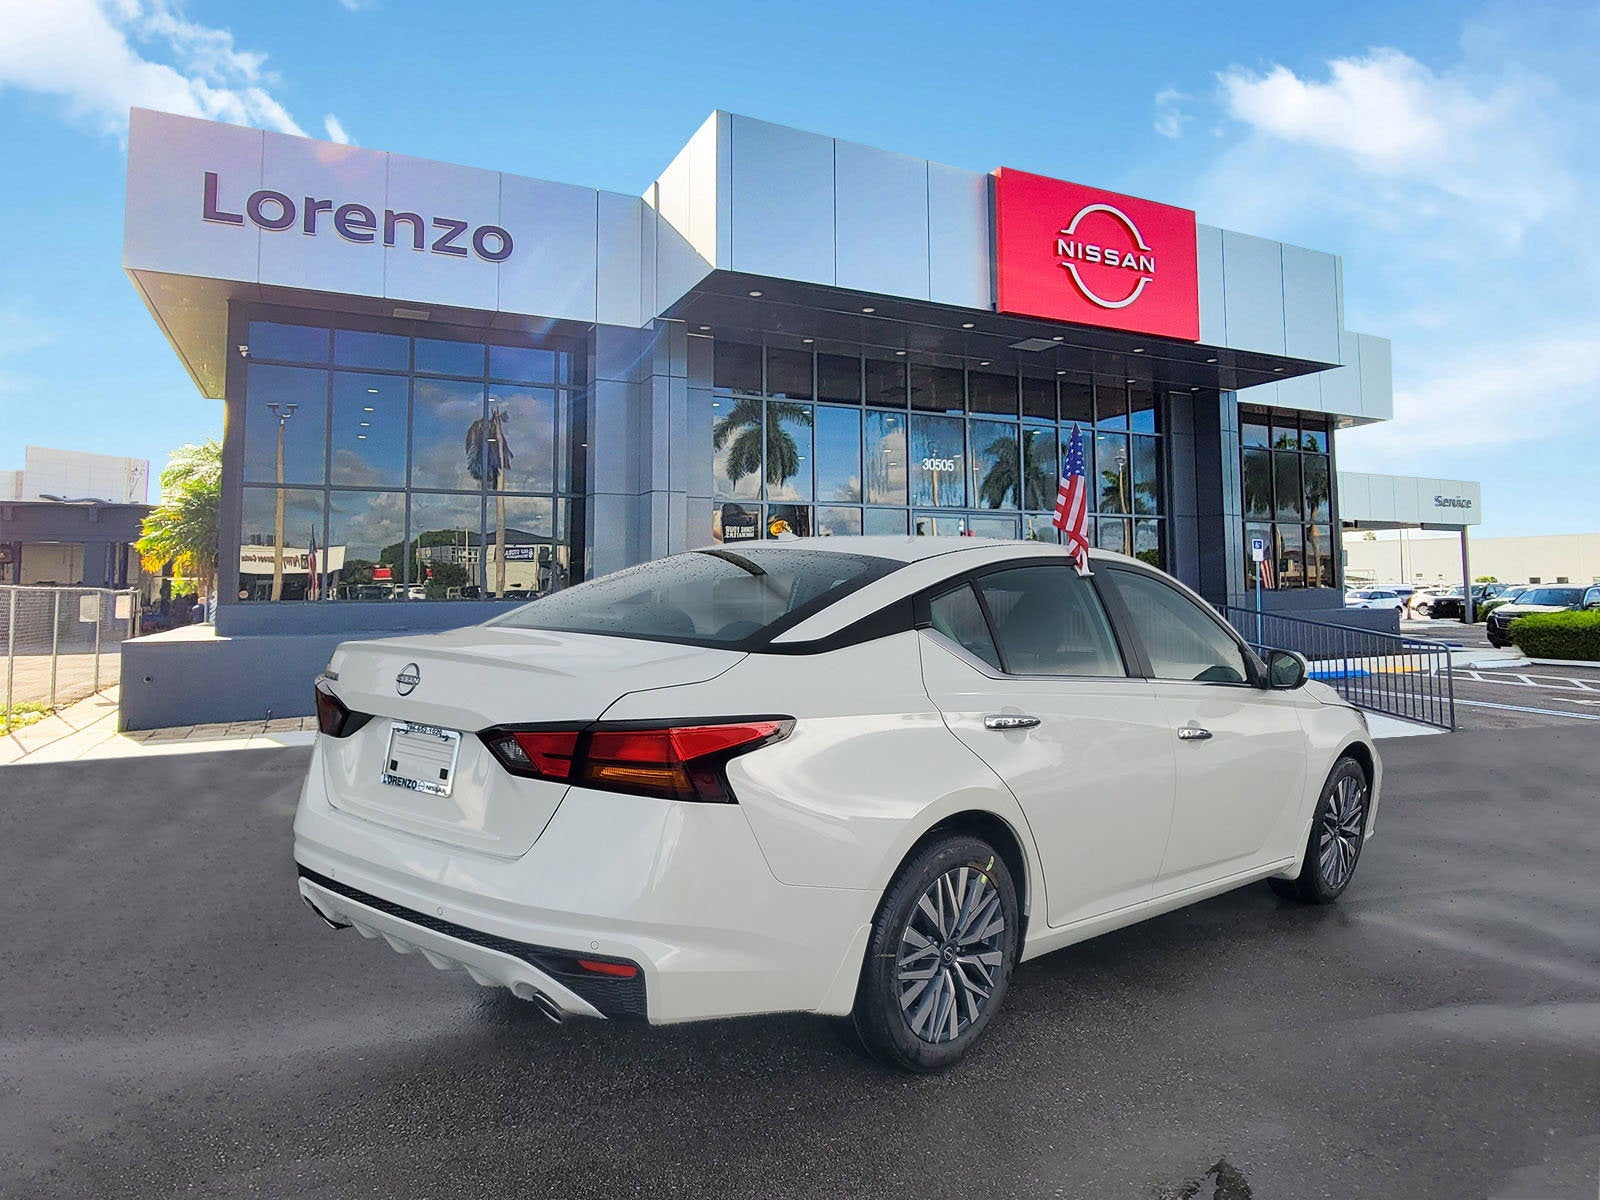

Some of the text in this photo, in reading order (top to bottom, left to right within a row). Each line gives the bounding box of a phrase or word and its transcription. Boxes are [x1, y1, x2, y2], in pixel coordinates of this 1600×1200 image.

[202, 170, 514, 264] Lorenzo
[1057, 238, 1155, 273] NISSAN
[922, 458, 954, 471] 30505
[1434, 495, 1472, 508] Service
[396, 674, 421, 685] NISSAN
[383, 773, 449, 796] LORENZO NISSAN
